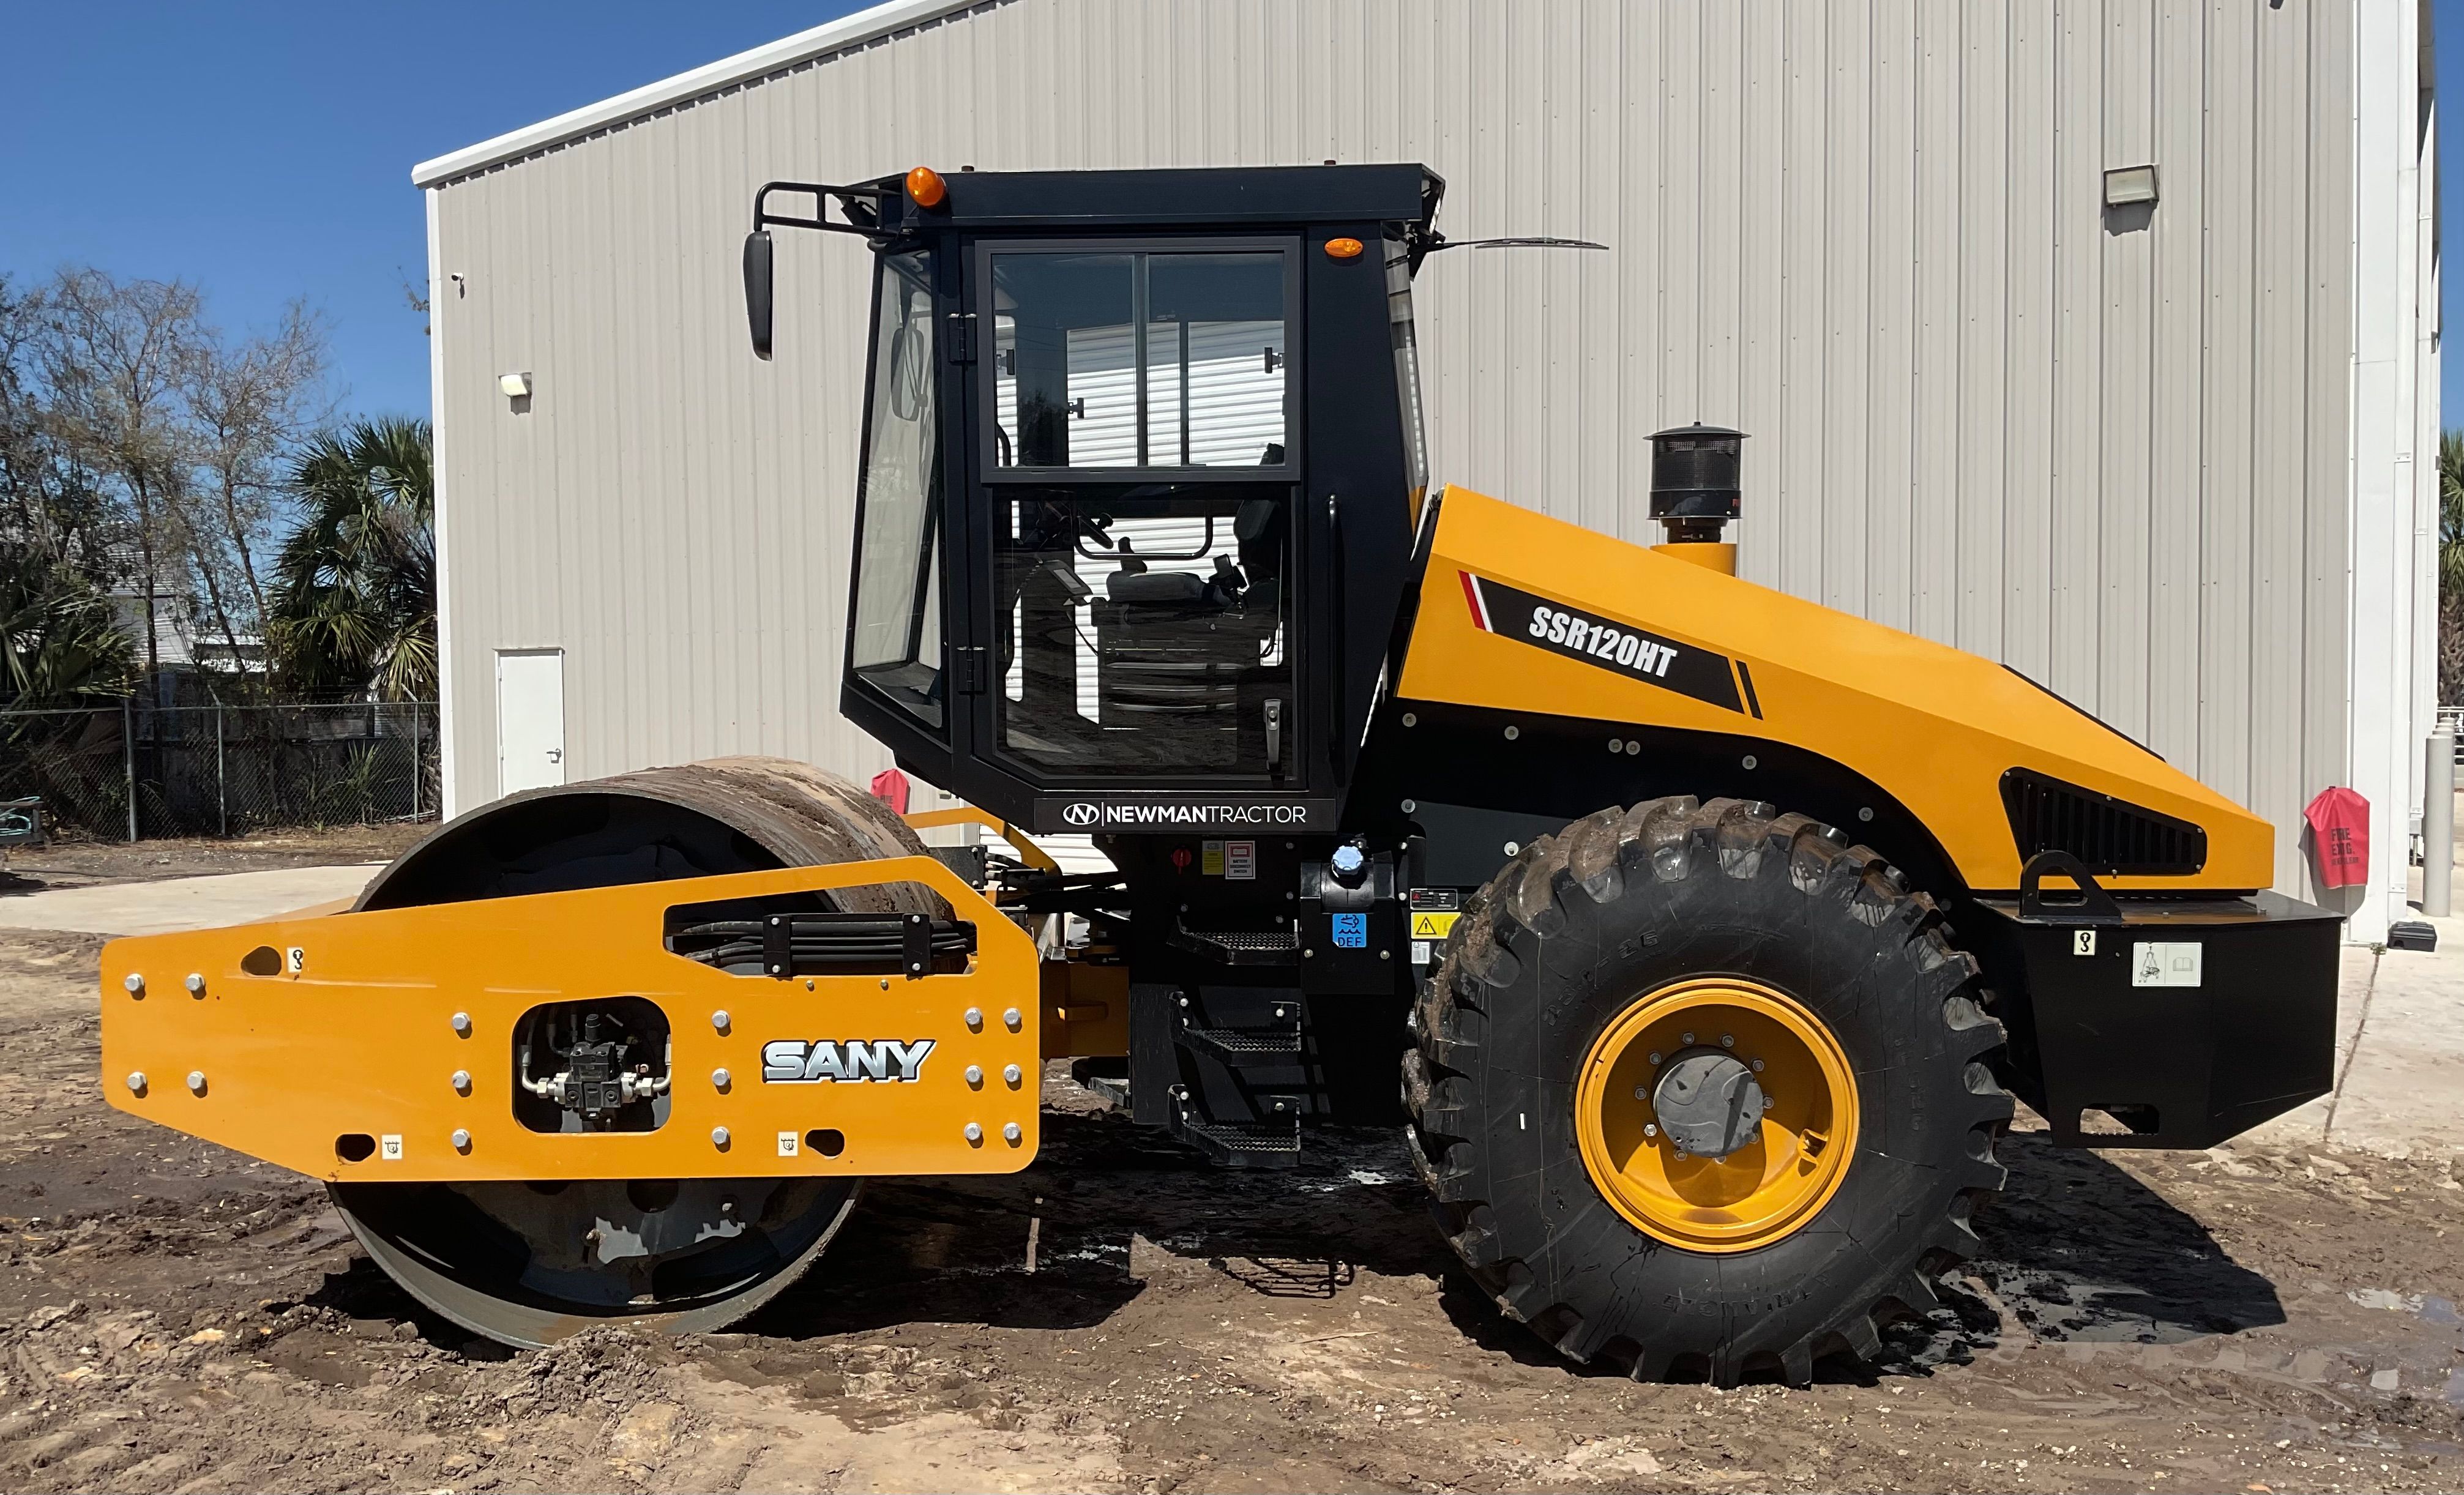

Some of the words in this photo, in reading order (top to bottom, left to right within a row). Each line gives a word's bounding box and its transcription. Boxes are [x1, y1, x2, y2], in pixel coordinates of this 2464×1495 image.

[1529, 606, 1678, 678] SSR120HT
[1337, 937, 1362, 947] DEF
[762, 1039, 936, 1081] SANY
